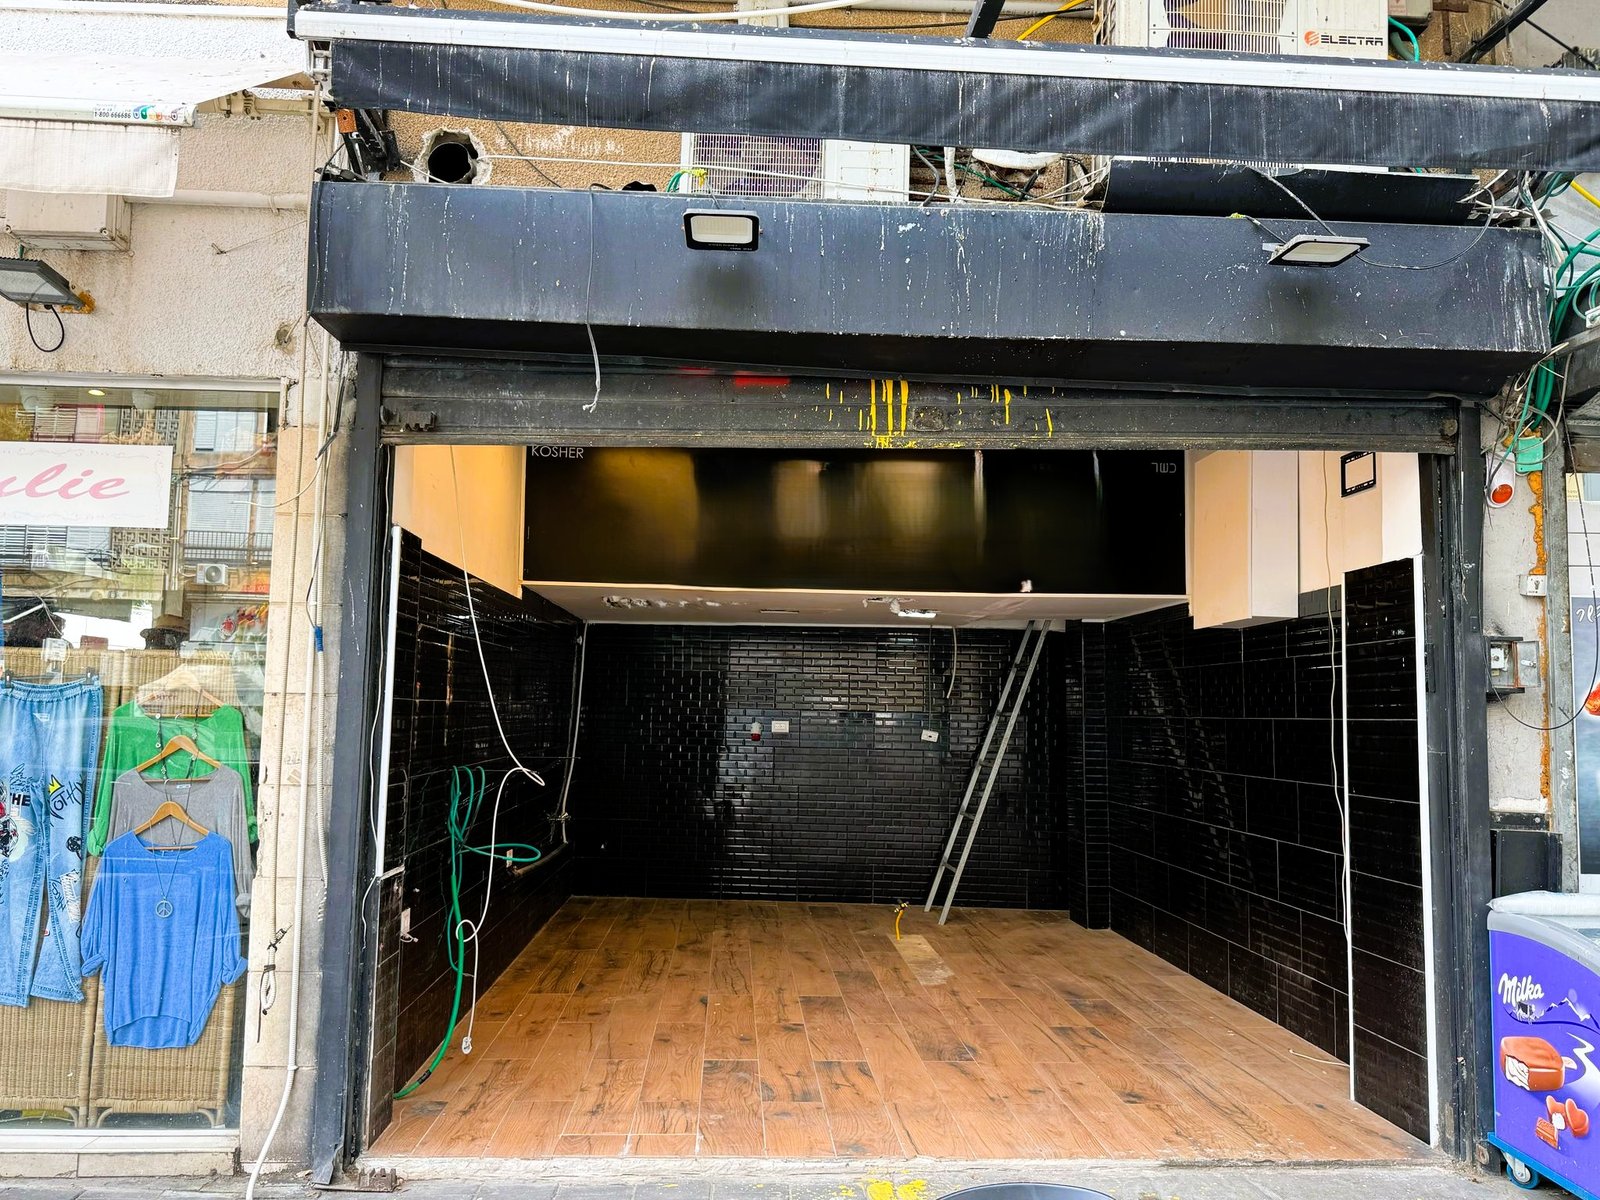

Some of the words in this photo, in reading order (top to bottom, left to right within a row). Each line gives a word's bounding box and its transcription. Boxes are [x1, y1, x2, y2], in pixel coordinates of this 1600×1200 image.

[1320, 34, 1384, 46] ELECTRA
[531, 445, 584, 459] KOSHER
[1151, 462, 1177, 474] כשר
[1498, 972, 1545, 1008] Milka
